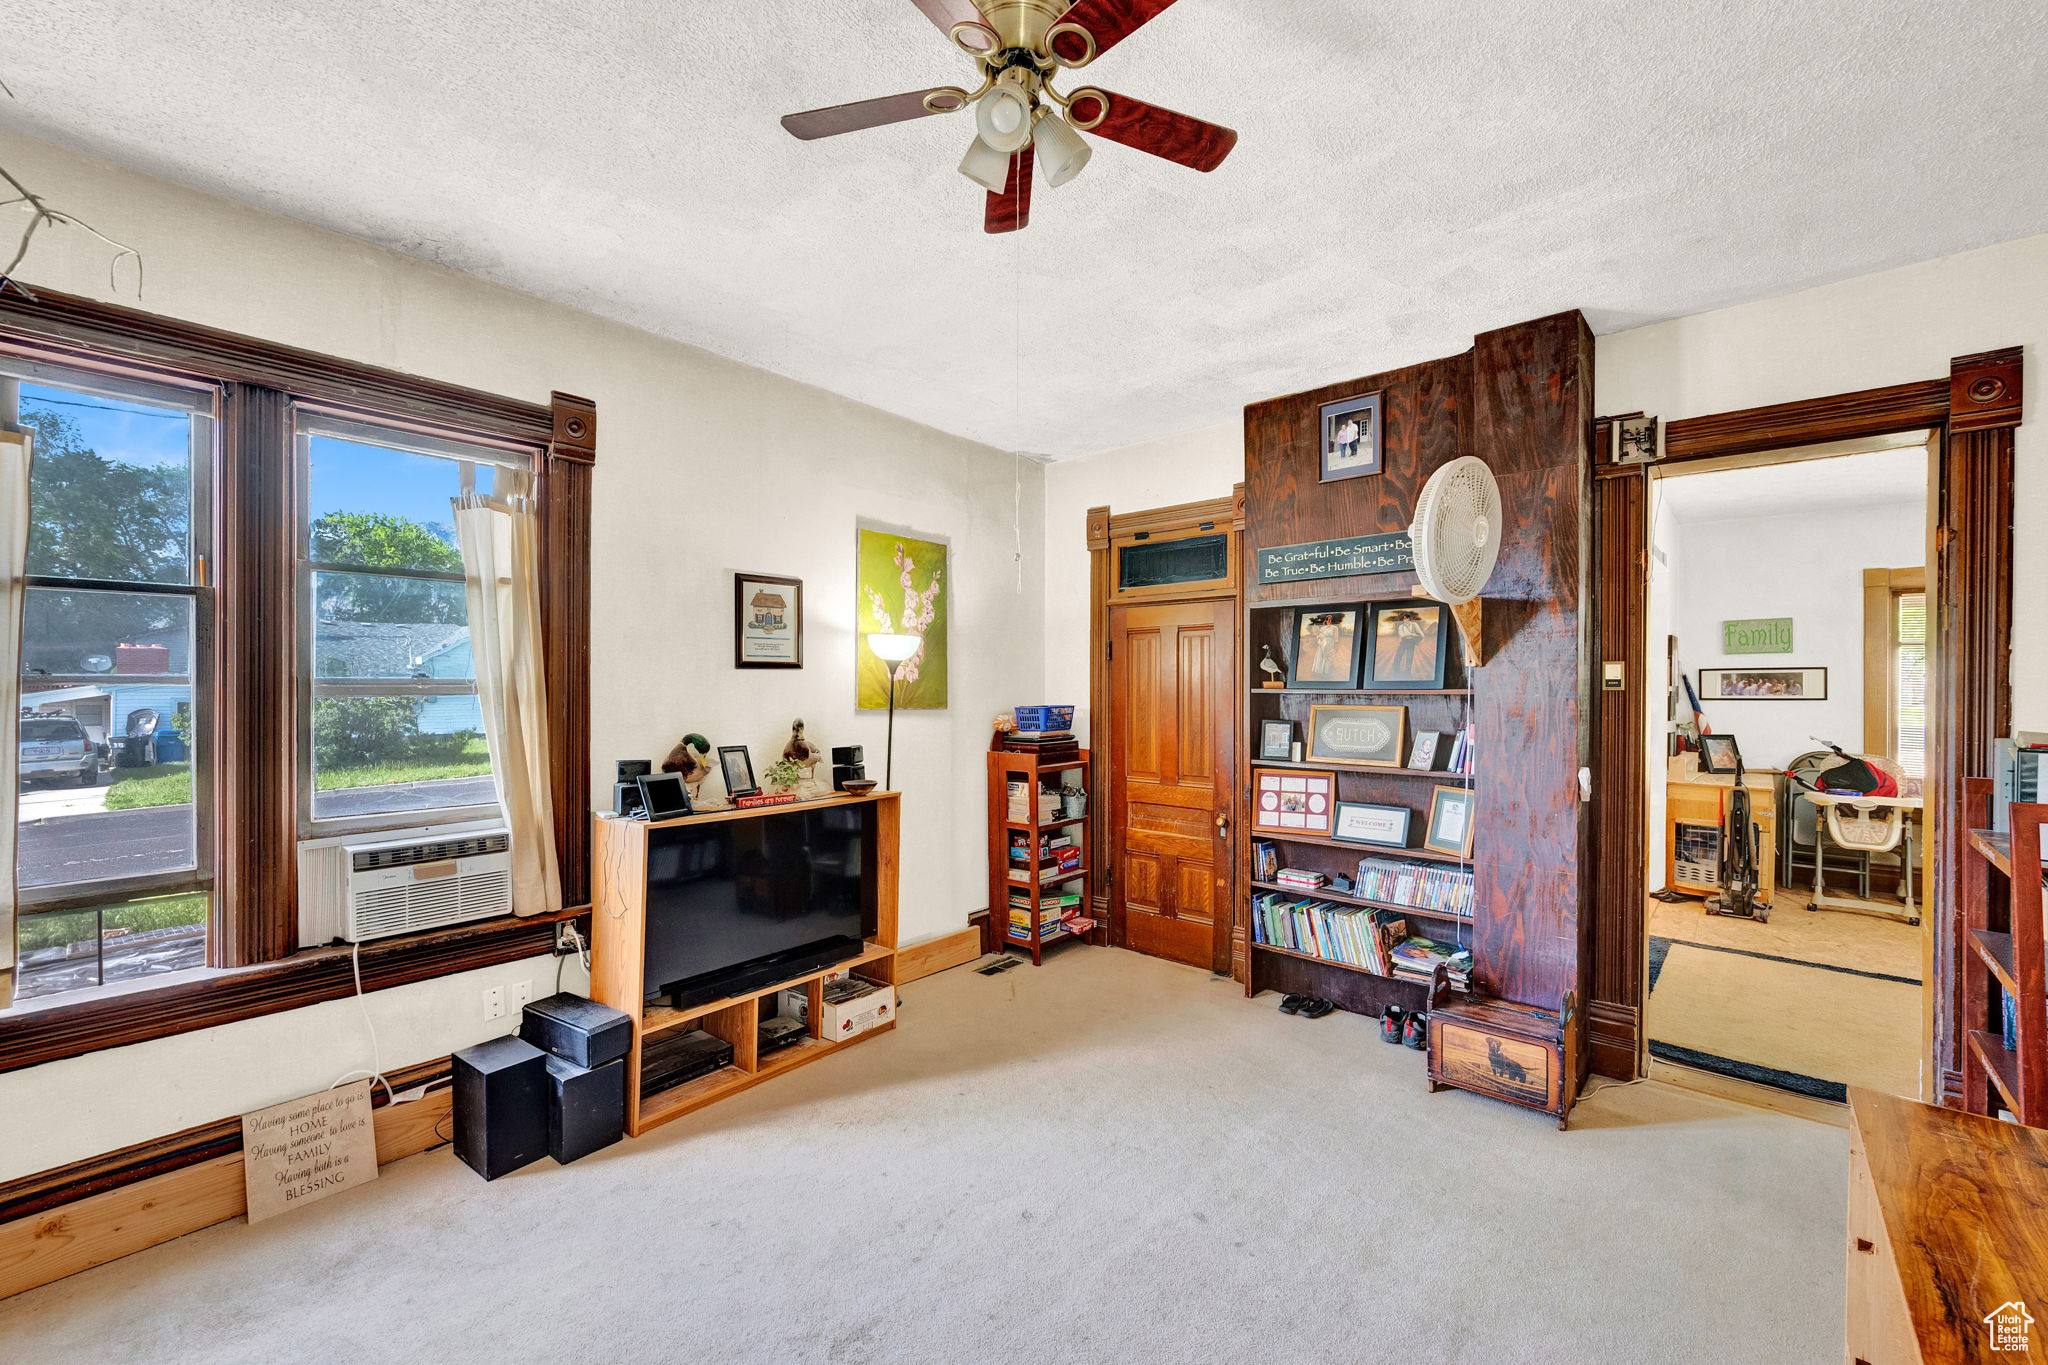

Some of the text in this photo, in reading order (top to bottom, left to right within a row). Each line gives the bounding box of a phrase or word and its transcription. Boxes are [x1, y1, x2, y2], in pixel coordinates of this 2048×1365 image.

[1268, 540, 1413, 564] Be Grateful Be Smart Be
[1265, 568, 1279, 578] Be
[1281, 566, 1305, 577] True
[1310, 563, 1326, 574] Be
[1328, 556, 1372, 572] Humble
[1377, 556, 1394, 567] Be
[1725, 621, 1791, 651] Family
[1336, 727, 1375, 743] SUTCH
[1355, 819, 1387, 828] WELCOME
[250, 1092, 364, 1132] Having some place to go is
[290, 1116, 329, 1136] HOME
[251, 1118, 366, 1161] Having someone to love is
[288, 1141, 333, 1166] FAMILY
[275, 1169, 311, 1186] Having
[314, 1157, 333, 1174] both
[334, 1156, 343, 1167] is
[286, 1172, 344, 1201] BLESSING
